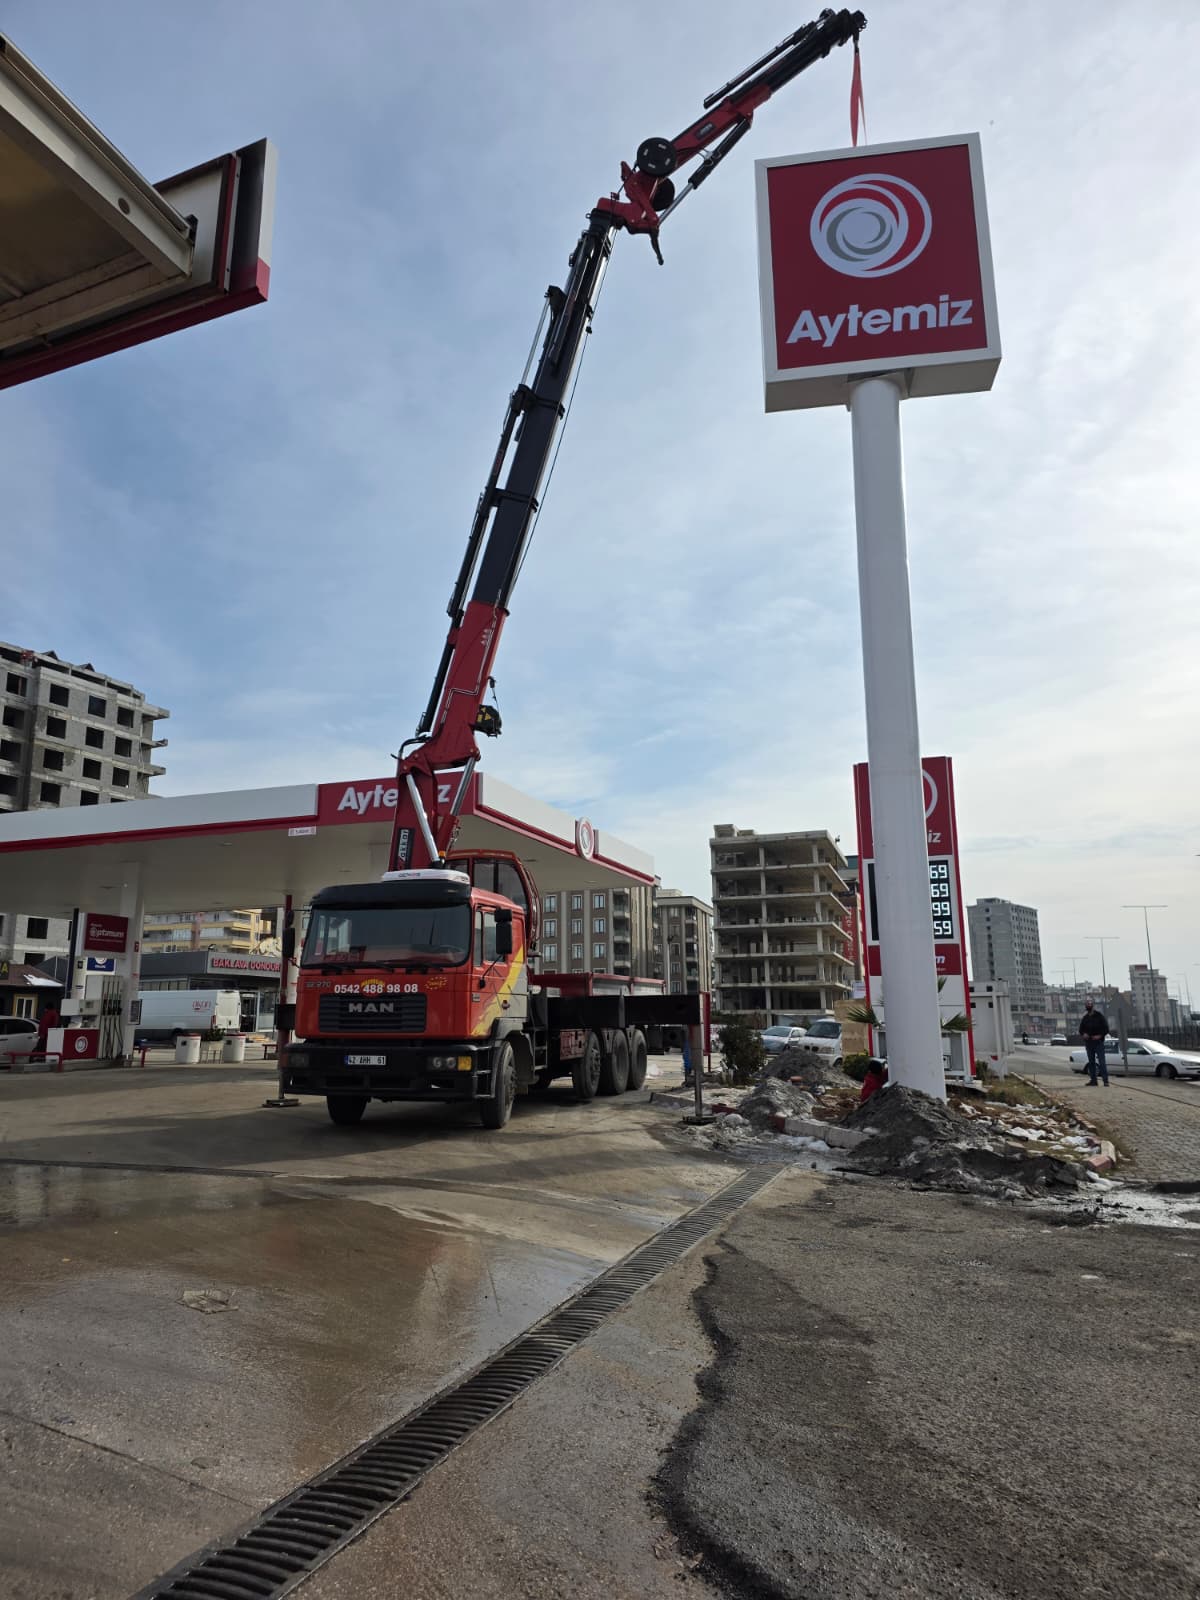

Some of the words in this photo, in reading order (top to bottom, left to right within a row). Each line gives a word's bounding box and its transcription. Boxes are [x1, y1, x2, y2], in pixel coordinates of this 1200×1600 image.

[786, 294, 973, 347] Aytemiz
[337, 784, 452, 815] Aytez
[334, 984, 360, 994] 0542
[363, 984, 383, 994] 488
[386, 984, 401, 993] 98
[404, 983, 418, 993] 08
[348, 1002, 394, 1013] MAN
